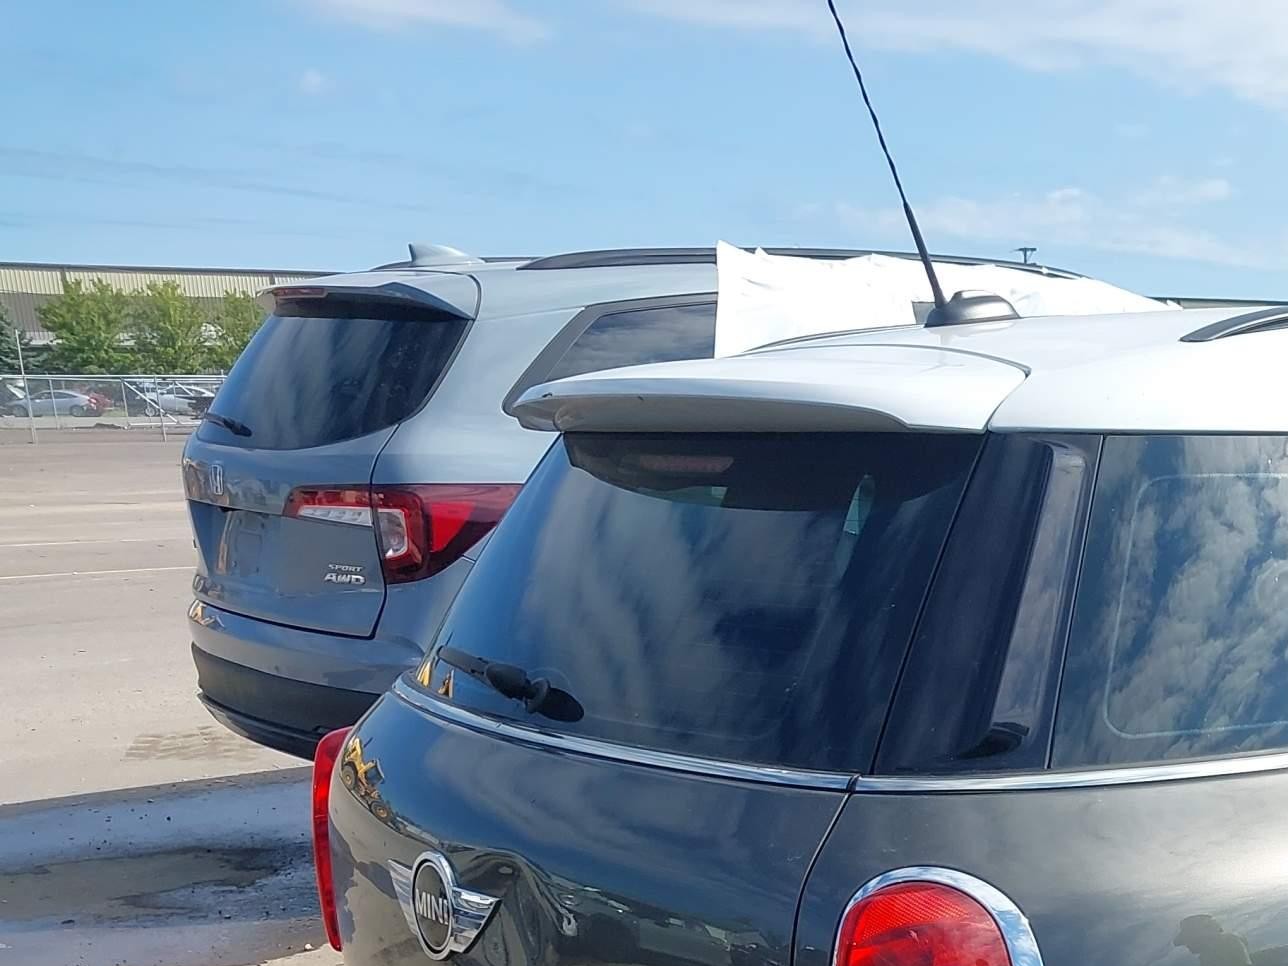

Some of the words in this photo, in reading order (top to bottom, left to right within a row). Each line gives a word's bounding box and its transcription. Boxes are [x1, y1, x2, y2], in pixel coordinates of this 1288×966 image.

[328, 564, 363, 572] SPORT
[324, 572, 366, 585] AWD
[415, 888, 449, 925] MINI
